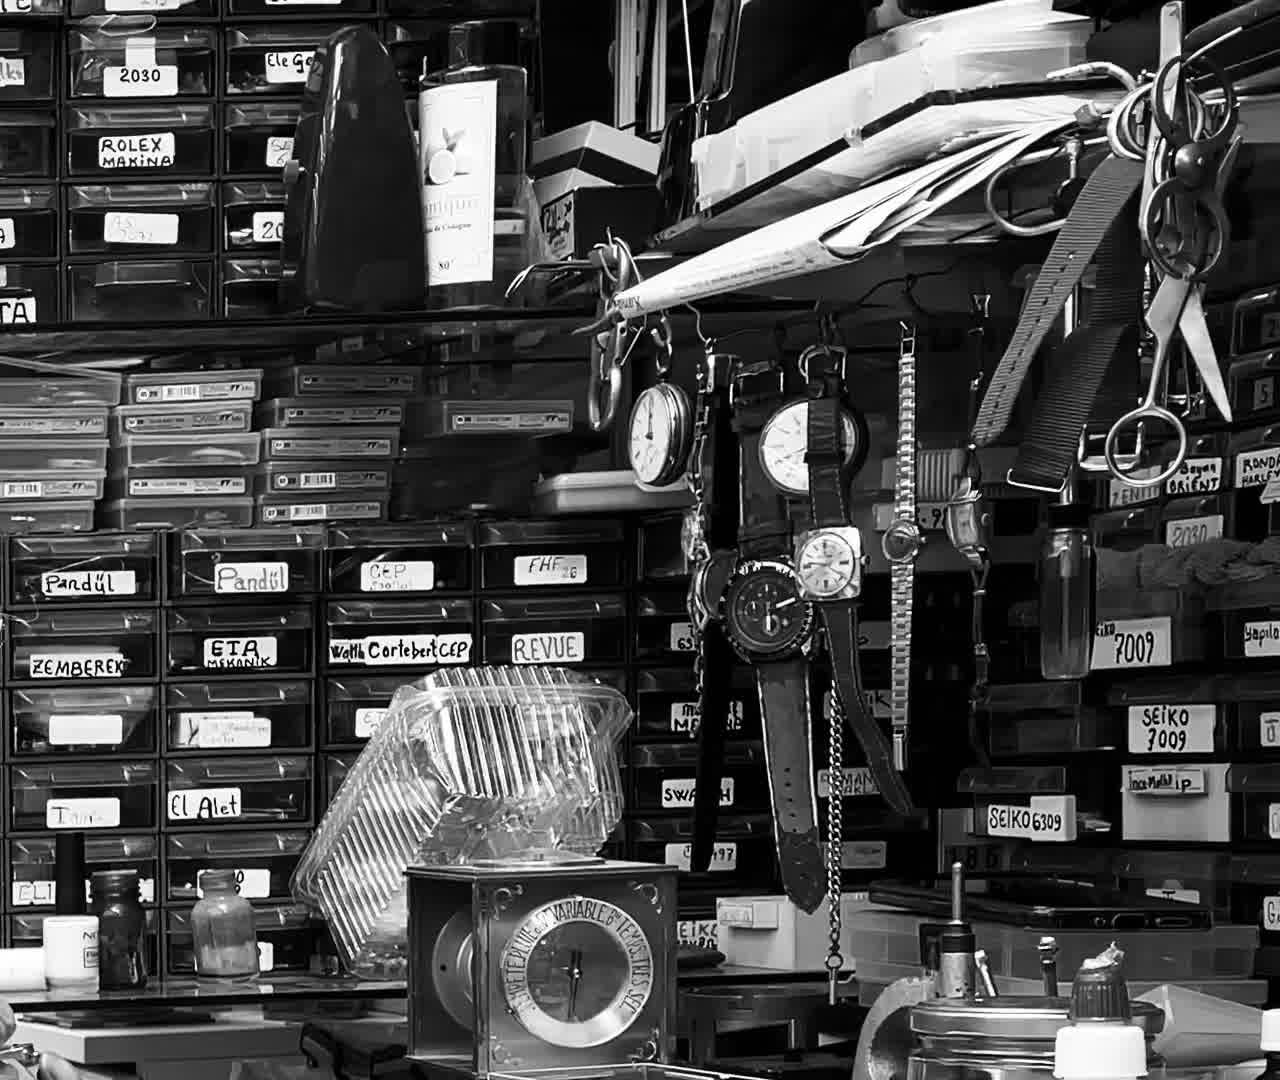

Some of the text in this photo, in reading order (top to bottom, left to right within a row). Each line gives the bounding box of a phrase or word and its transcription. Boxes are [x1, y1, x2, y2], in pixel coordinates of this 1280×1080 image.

[120, 68, 162, 83] 2030
[101, 137, 163, 153] ROLEX
[211, 640, 260, 657] ETA
[440, 641, 469, 659] CEP
[513, 635, 578, 662] REVUE
[1114, 631, 1154, 664] 7009
[1147, 728, 1188, 751] 7009
[197, 794, 238, 818] Alet
[989, 807, 1062, 832] SEIKO 6309
